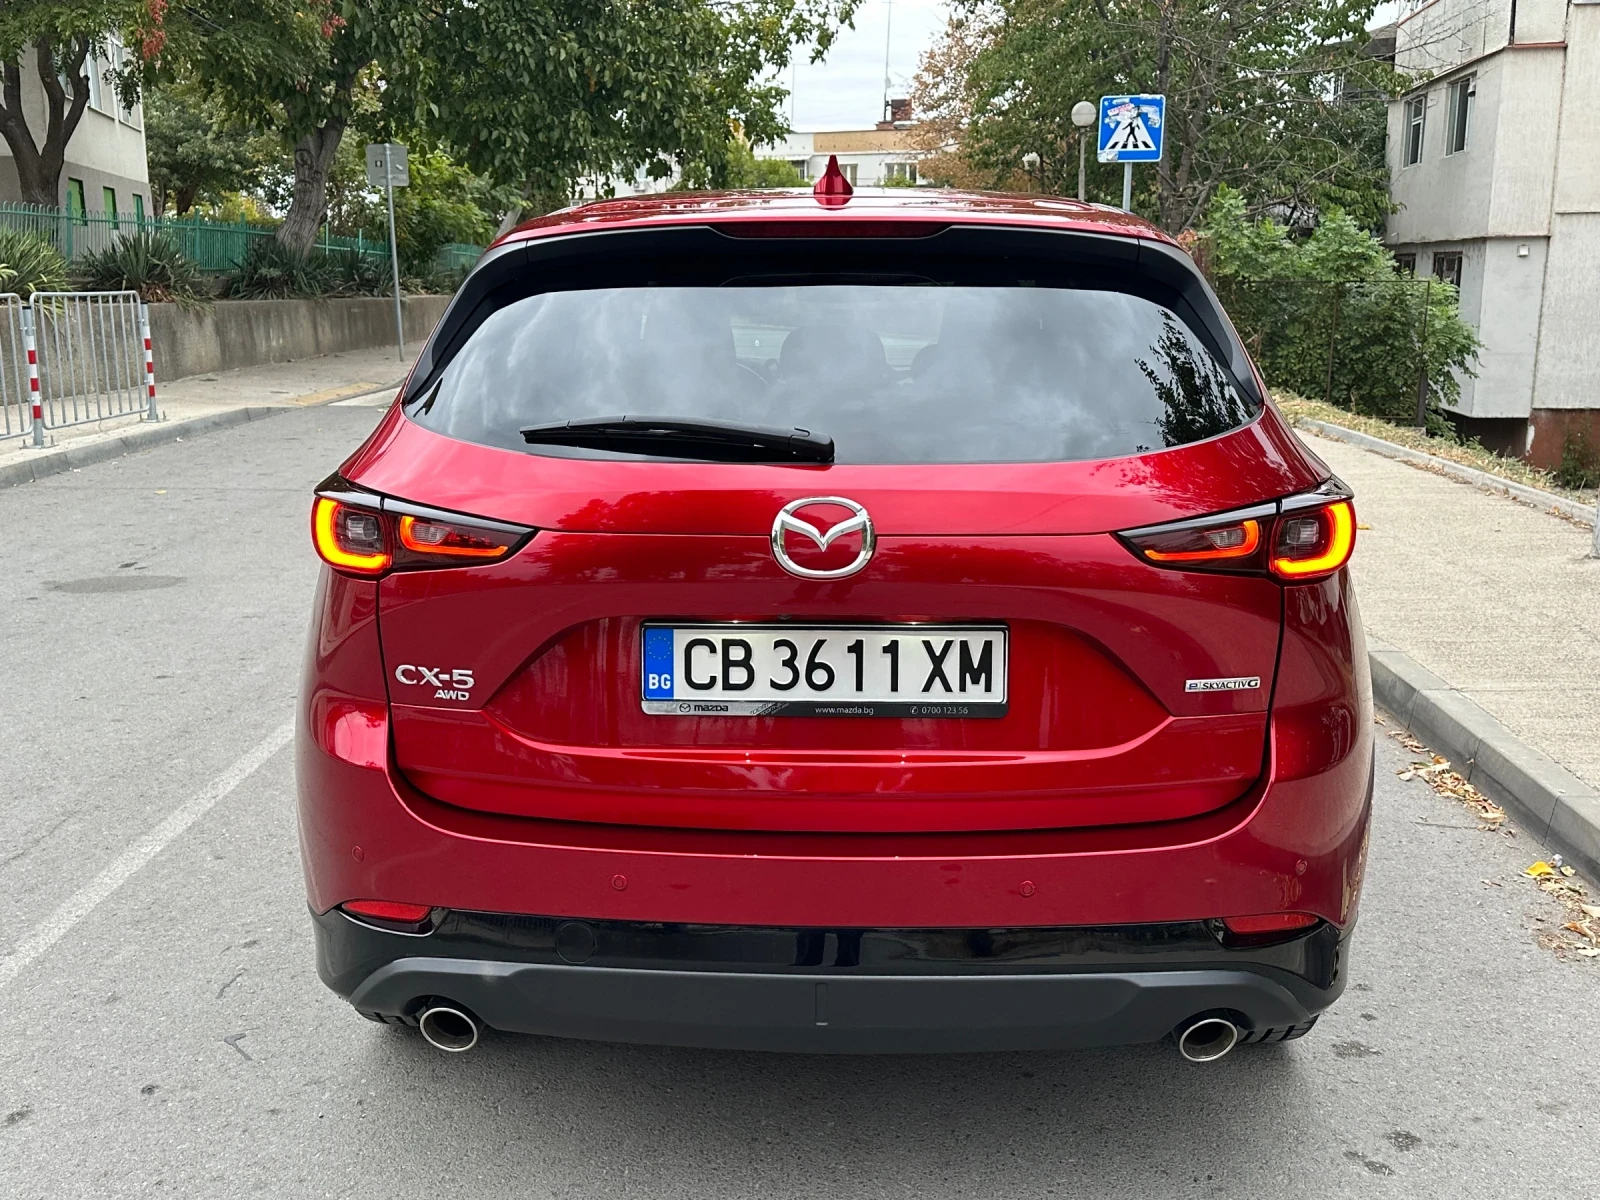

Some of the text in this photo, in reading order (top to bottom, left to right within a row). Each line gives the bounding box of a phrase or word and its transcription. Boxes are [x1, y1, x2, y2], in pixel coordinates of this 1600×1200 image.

[684, 639, 993, 693] CB 3611 XM
[395, 664, 475, 689] CX-5
[648, 674, 671, 690] BG
[434, 689, 470, 700] AWD
[694, 704, 728, 712] mazda
[815, 706, 874, 715] www.mazda.bg
[921, 706, 968, 714] 0700 123 56
